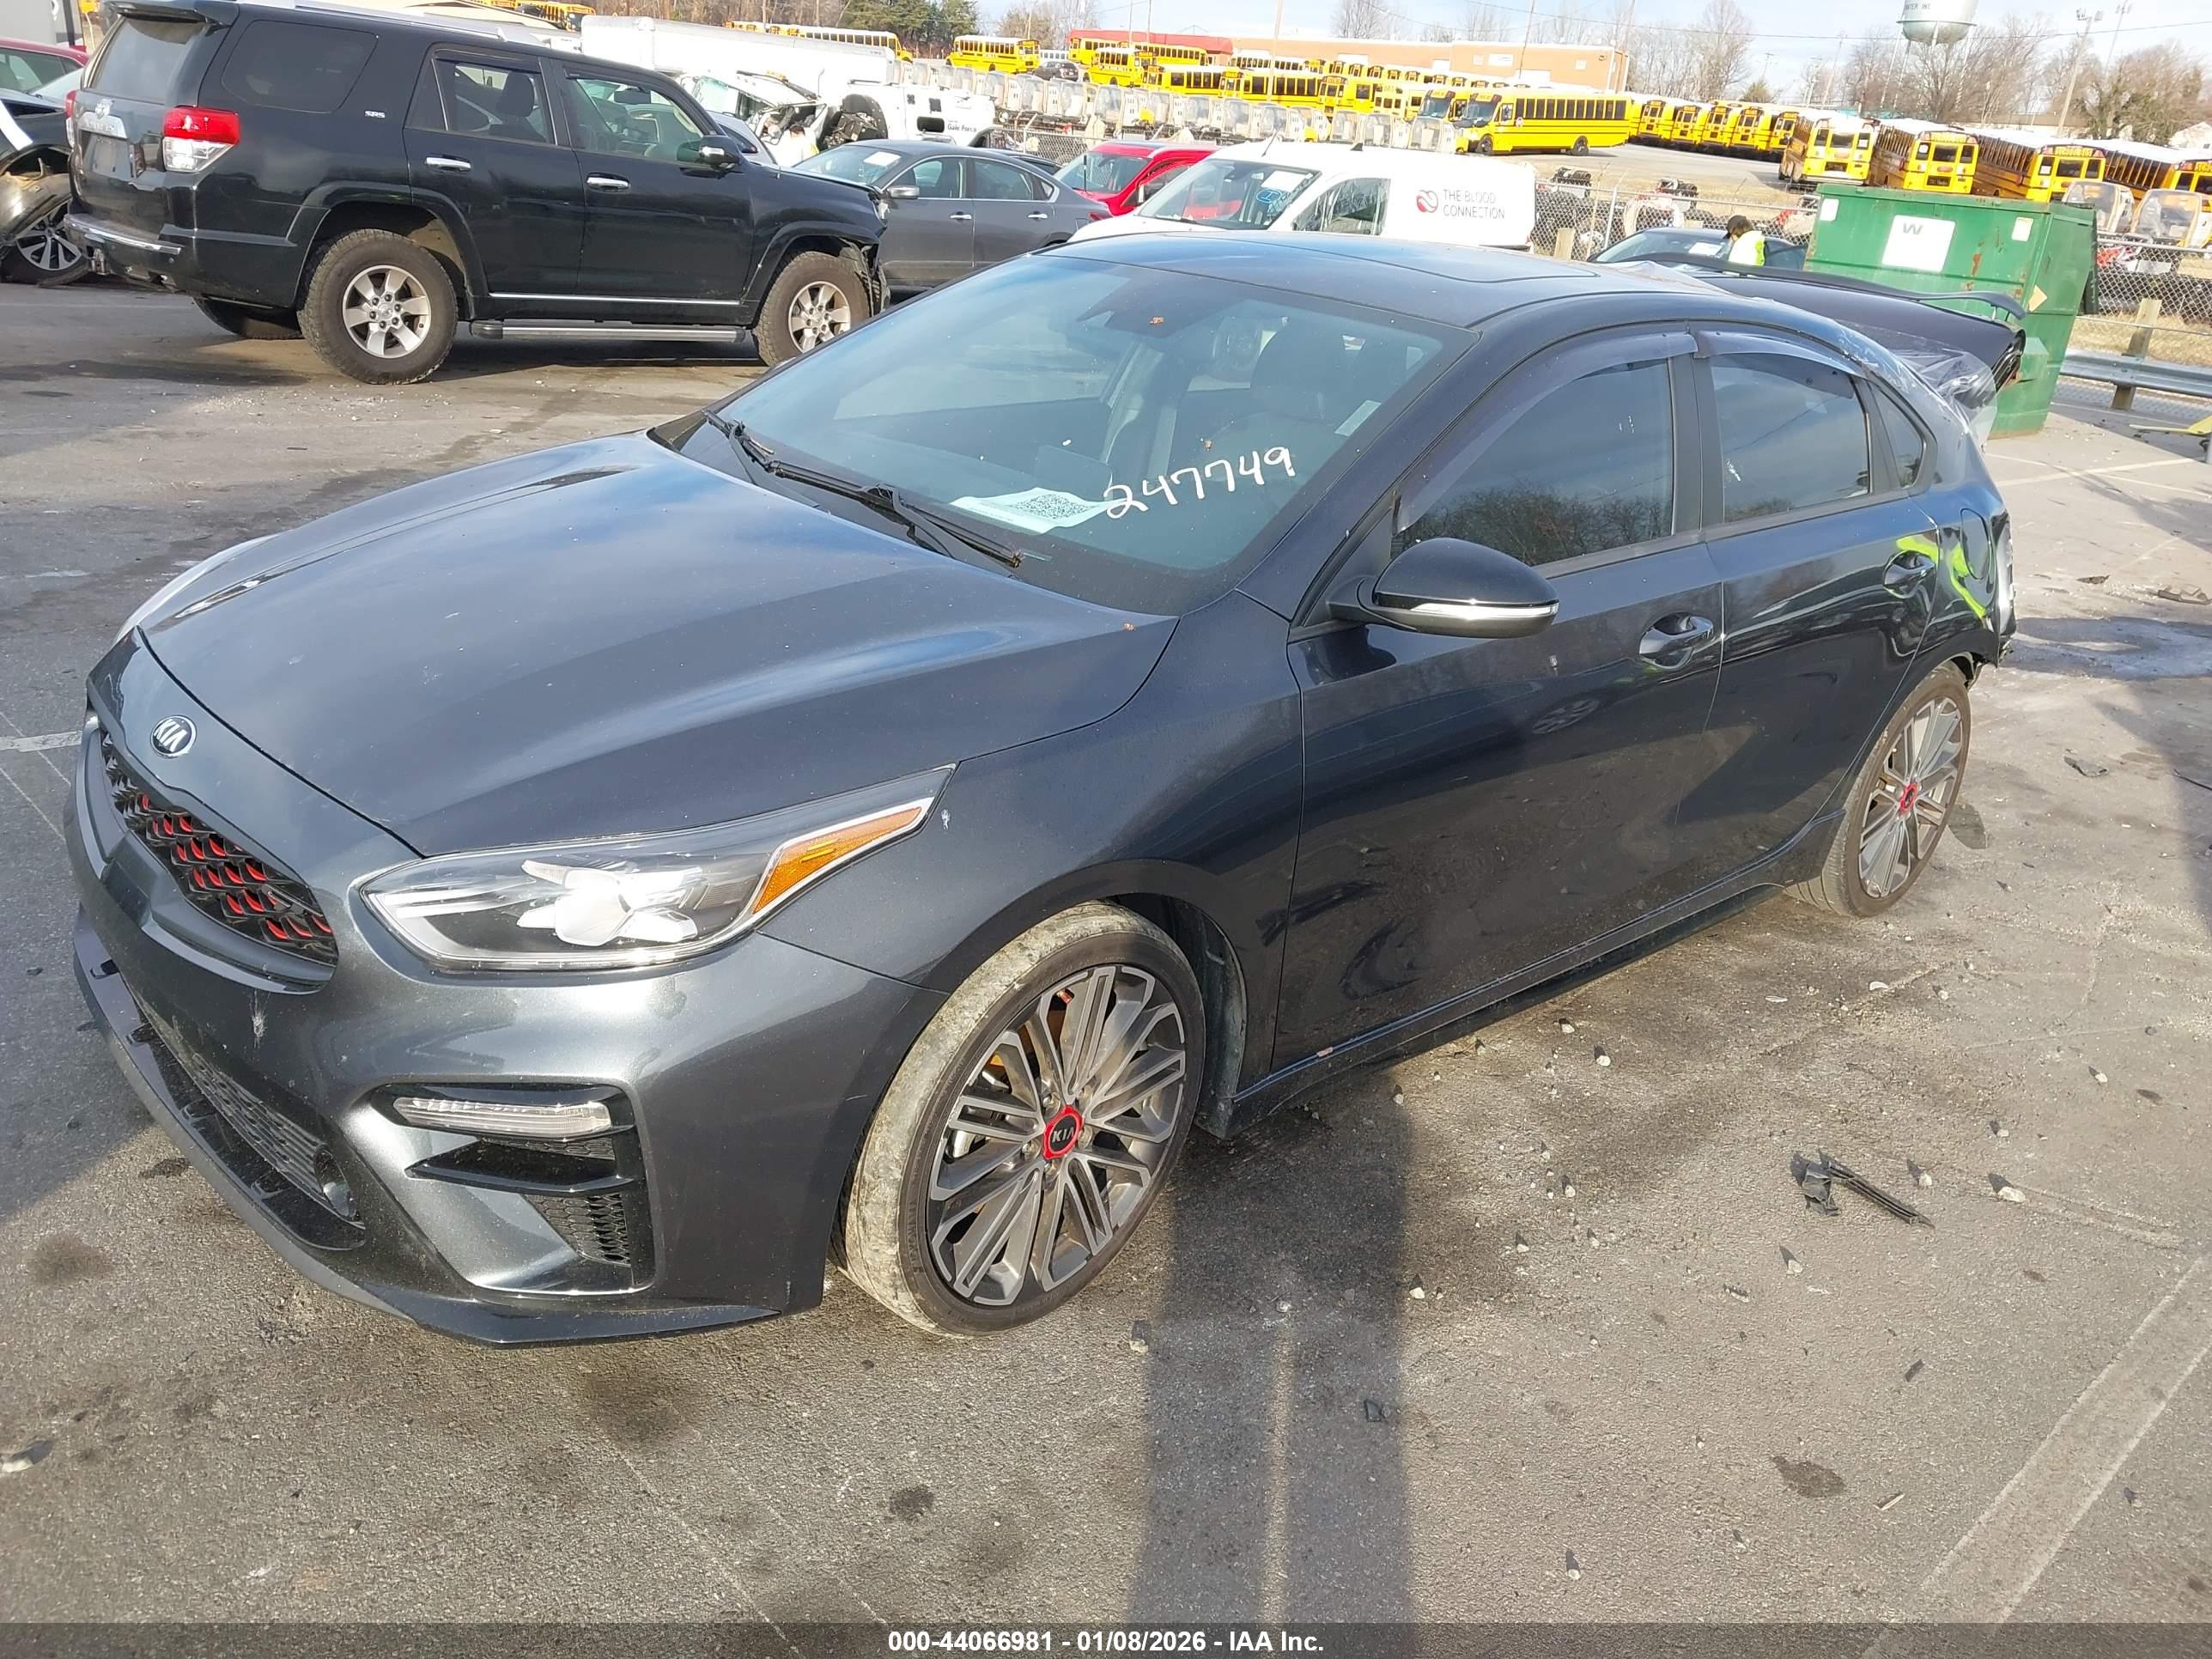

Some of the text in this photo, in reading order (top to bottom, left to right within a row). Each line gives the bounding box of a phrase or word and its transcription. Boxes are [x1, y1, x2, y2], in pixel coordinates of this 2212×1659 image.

[947, 123, 960, 131] Gale
[1443, 189, 1496, 204] THE BLOOD
[1443, 204, 1505, 219] CONNECTION
[1103, 447, 1296, 519] 247749
[153, 718, 187, 752] KIA
[1052, 1127, 1074, 1143] KIA
